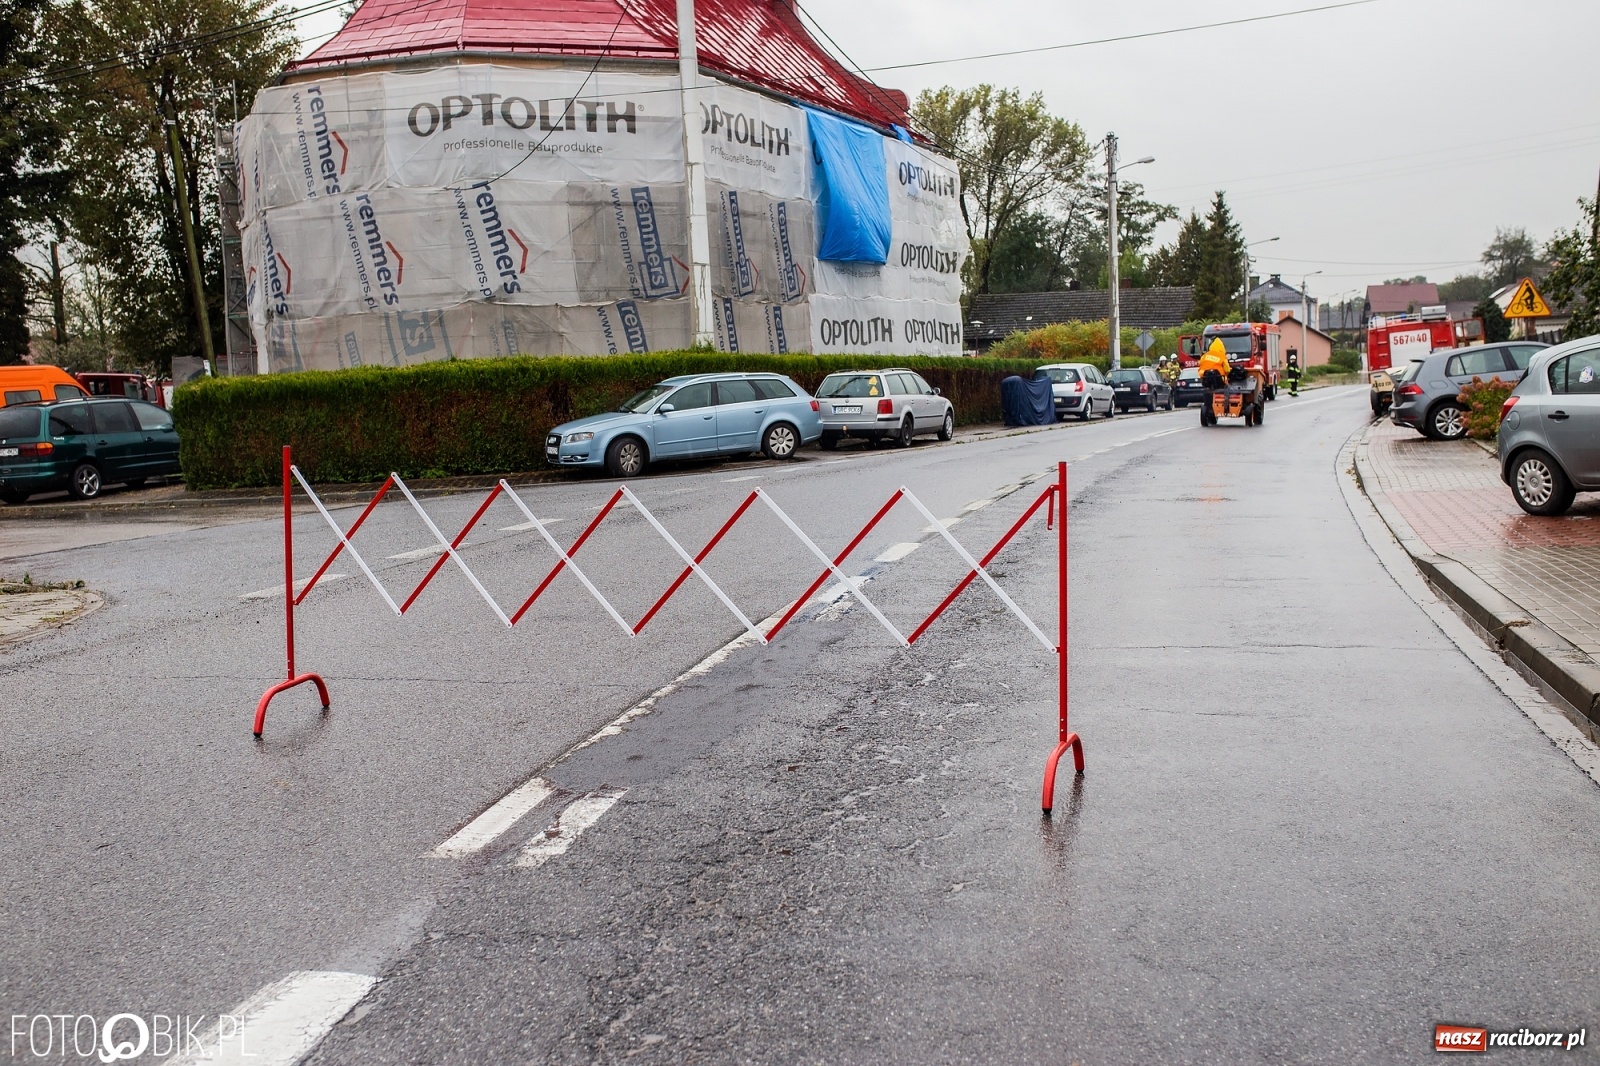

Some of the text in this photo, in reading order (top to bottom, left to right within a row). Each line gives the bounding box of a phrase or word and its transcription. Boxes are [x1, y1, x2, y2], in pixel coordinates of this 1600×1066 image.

[308, 85, 341, 195] remmers
[527, 141, 603, 154] Bauprodukte
[340, 200, 378, 310] www.remmers.pl
[356, 193, 399, 306] remmers
[454, 187, 495, 300] www.remmers.pl
[472, 180, 521, 294] remmers
[610, 188, 643, 299] www.remmers.pl
[633, 189, 665, 286] remmers
[730, 194, 750, 286] remmers
[778, 205, 796, 290] remmers
[820, 317, 960, 346] OPTOLITH OPTOLITH
